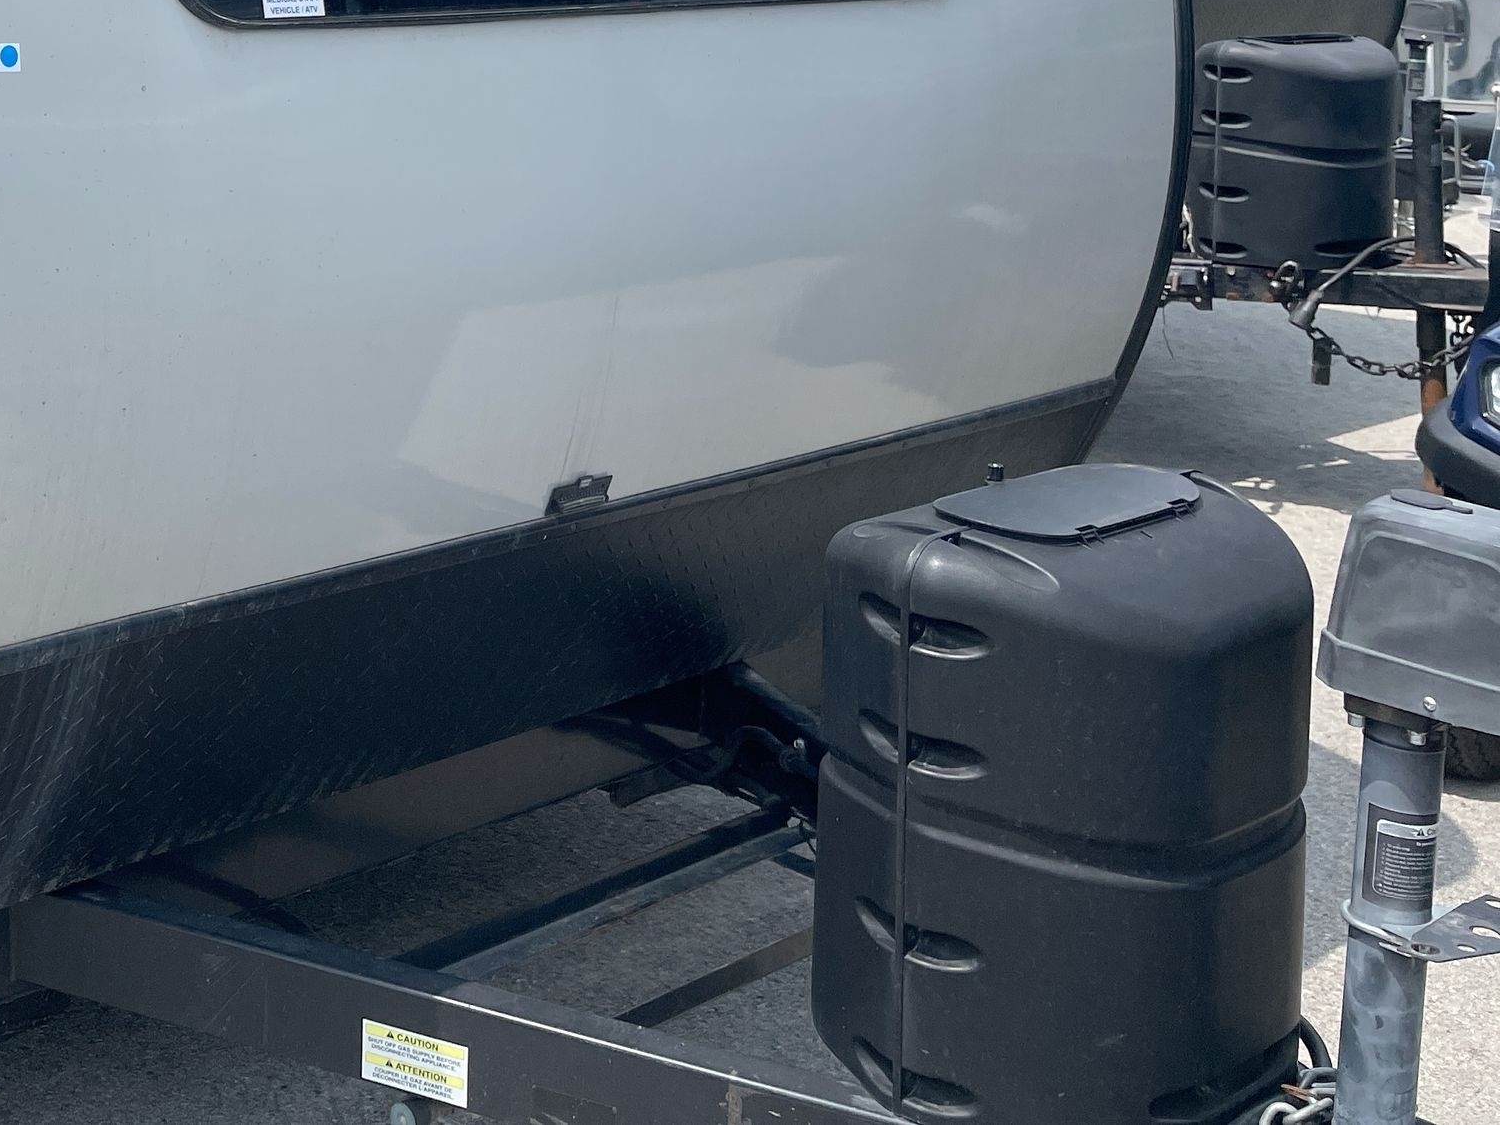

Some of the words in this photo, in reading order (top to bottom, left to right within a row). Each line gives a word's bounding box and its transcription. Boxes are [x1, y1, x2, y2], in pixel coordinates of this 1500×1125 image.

[397, 1033, 438, 1051] CAUTION
[368, 1036, 383, 1044] SHUT
[398, 1044, 410, 1052] GAS
[412, 1048, 435, 1059] SUPPLY
[436, 1055, 460, 1067] BEFORE
[371, 1044, 420, 1061] DISCONNECTING
[396, 1063, 446, 1083] ATTENTION
[410, 1076, 422, 1084] GAZ
[424, 1080, 443, 1090] AVANT
